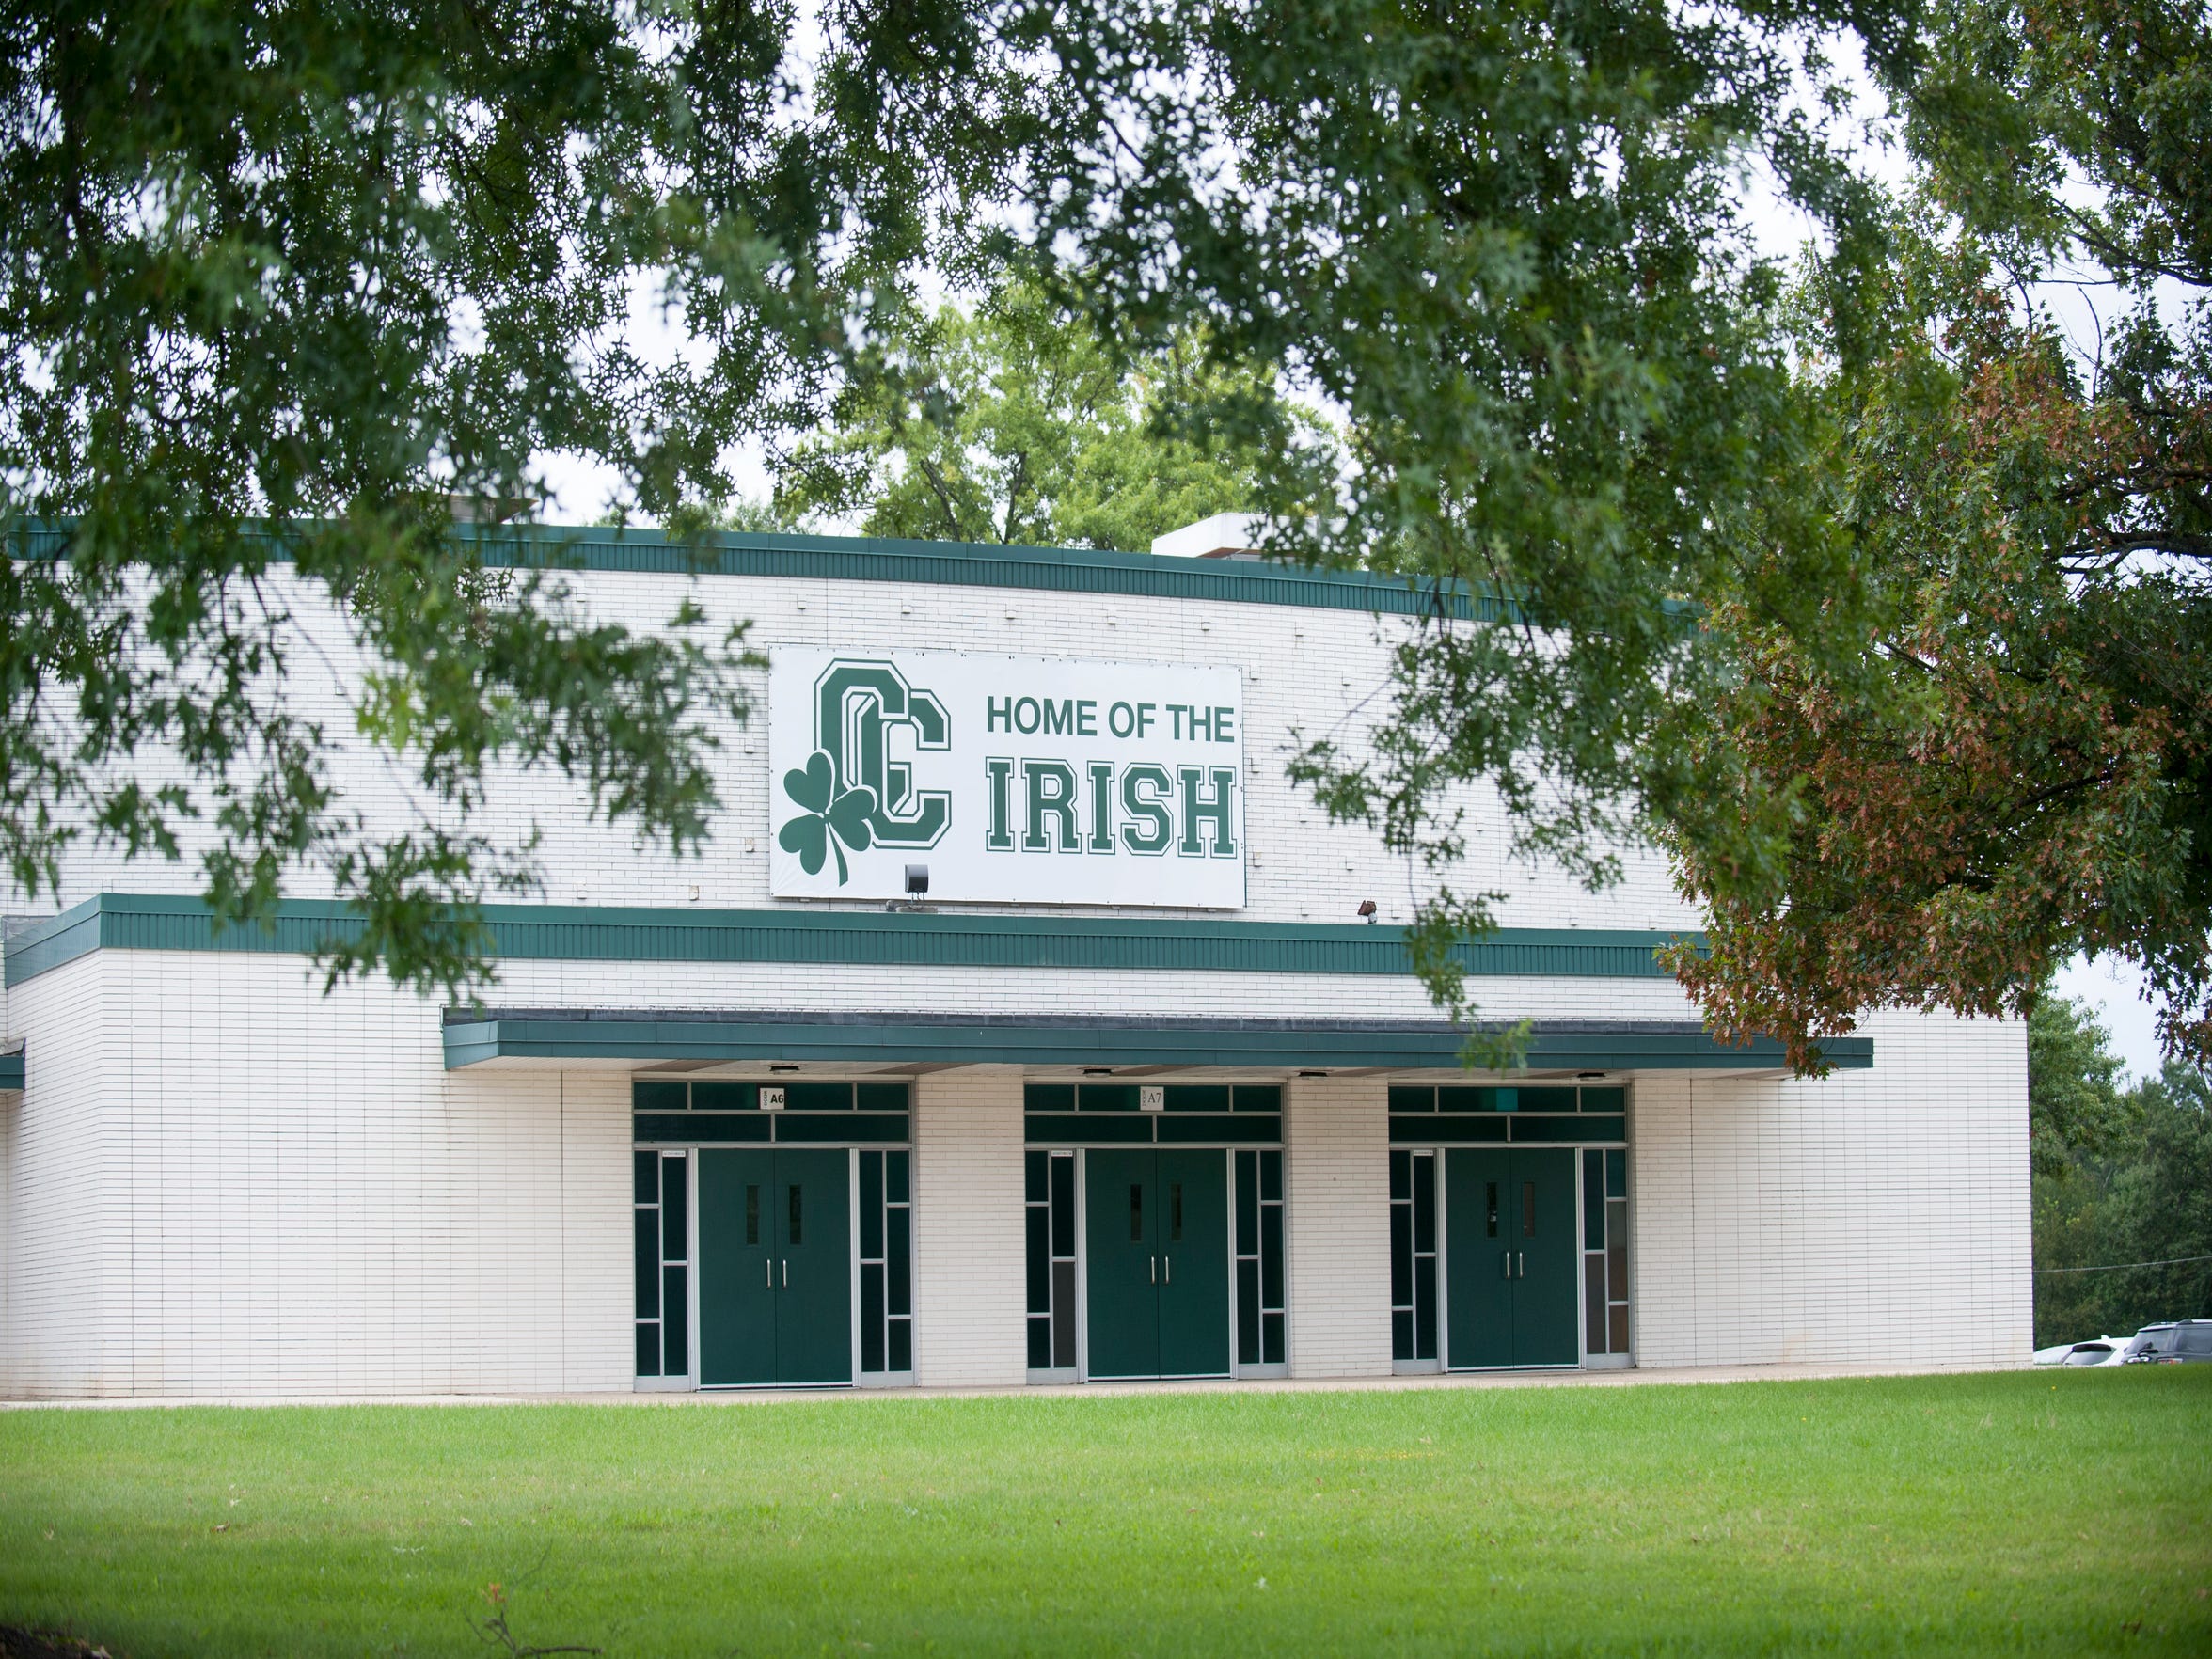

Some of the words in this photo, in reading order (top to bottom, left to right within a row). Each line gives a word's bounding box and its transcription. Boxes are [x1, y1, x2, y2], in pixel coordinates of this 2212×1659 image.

[988, 696, 1098, 736] HOME
[1108, 701, 1156, 739] OF
[1166, 703, 1235, 743] THE
[986, 756, 1238, 859] IRISH
[770, 1094, 784, 1104] A6
[1147, 1092, 1161, 1103] A7
